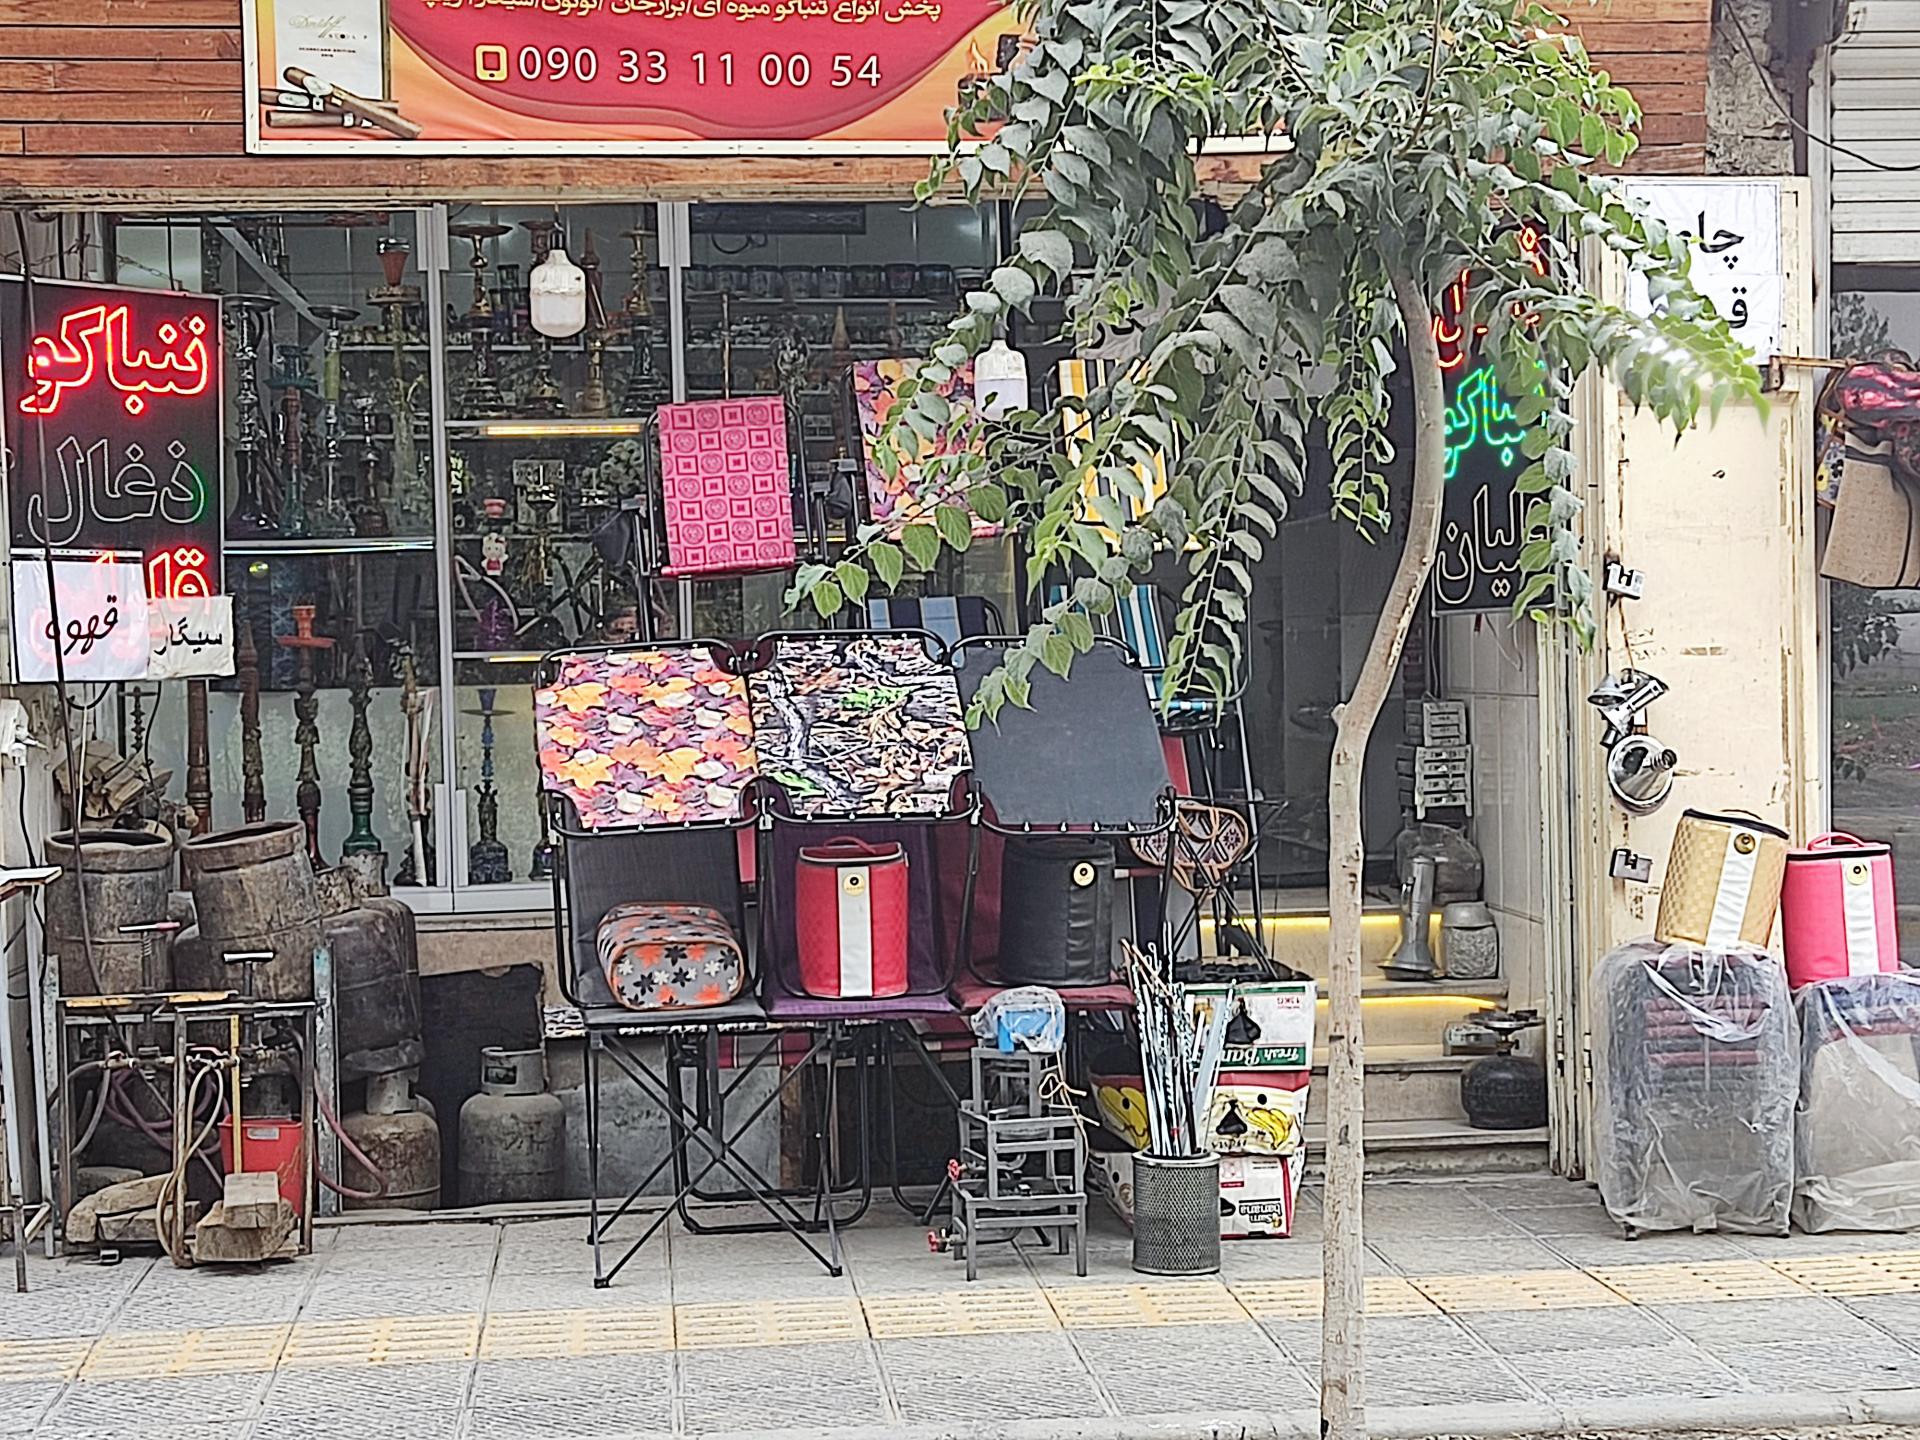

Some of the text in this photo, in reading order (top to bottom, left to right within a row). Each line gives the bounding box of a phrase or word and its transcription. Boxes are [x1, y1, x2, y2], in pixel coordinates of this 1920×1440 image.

[726, 2, 771, 21] میوه
[773, 0, 829, 21] تنباکو
[832, 0, 881, 23] انواع
[518, 46, 882, 88] 090 33 11 00 54
[1676, 210, 1746, 270] چا
[27, 435, 206, 546] ذغال
[45, 594, 119, 656] قهوه
[153, 616, 223, 656] سیگار
[1263, 1047, 1300, 1061] Fresh
[1239, 1202, 1283, 1217] banana
